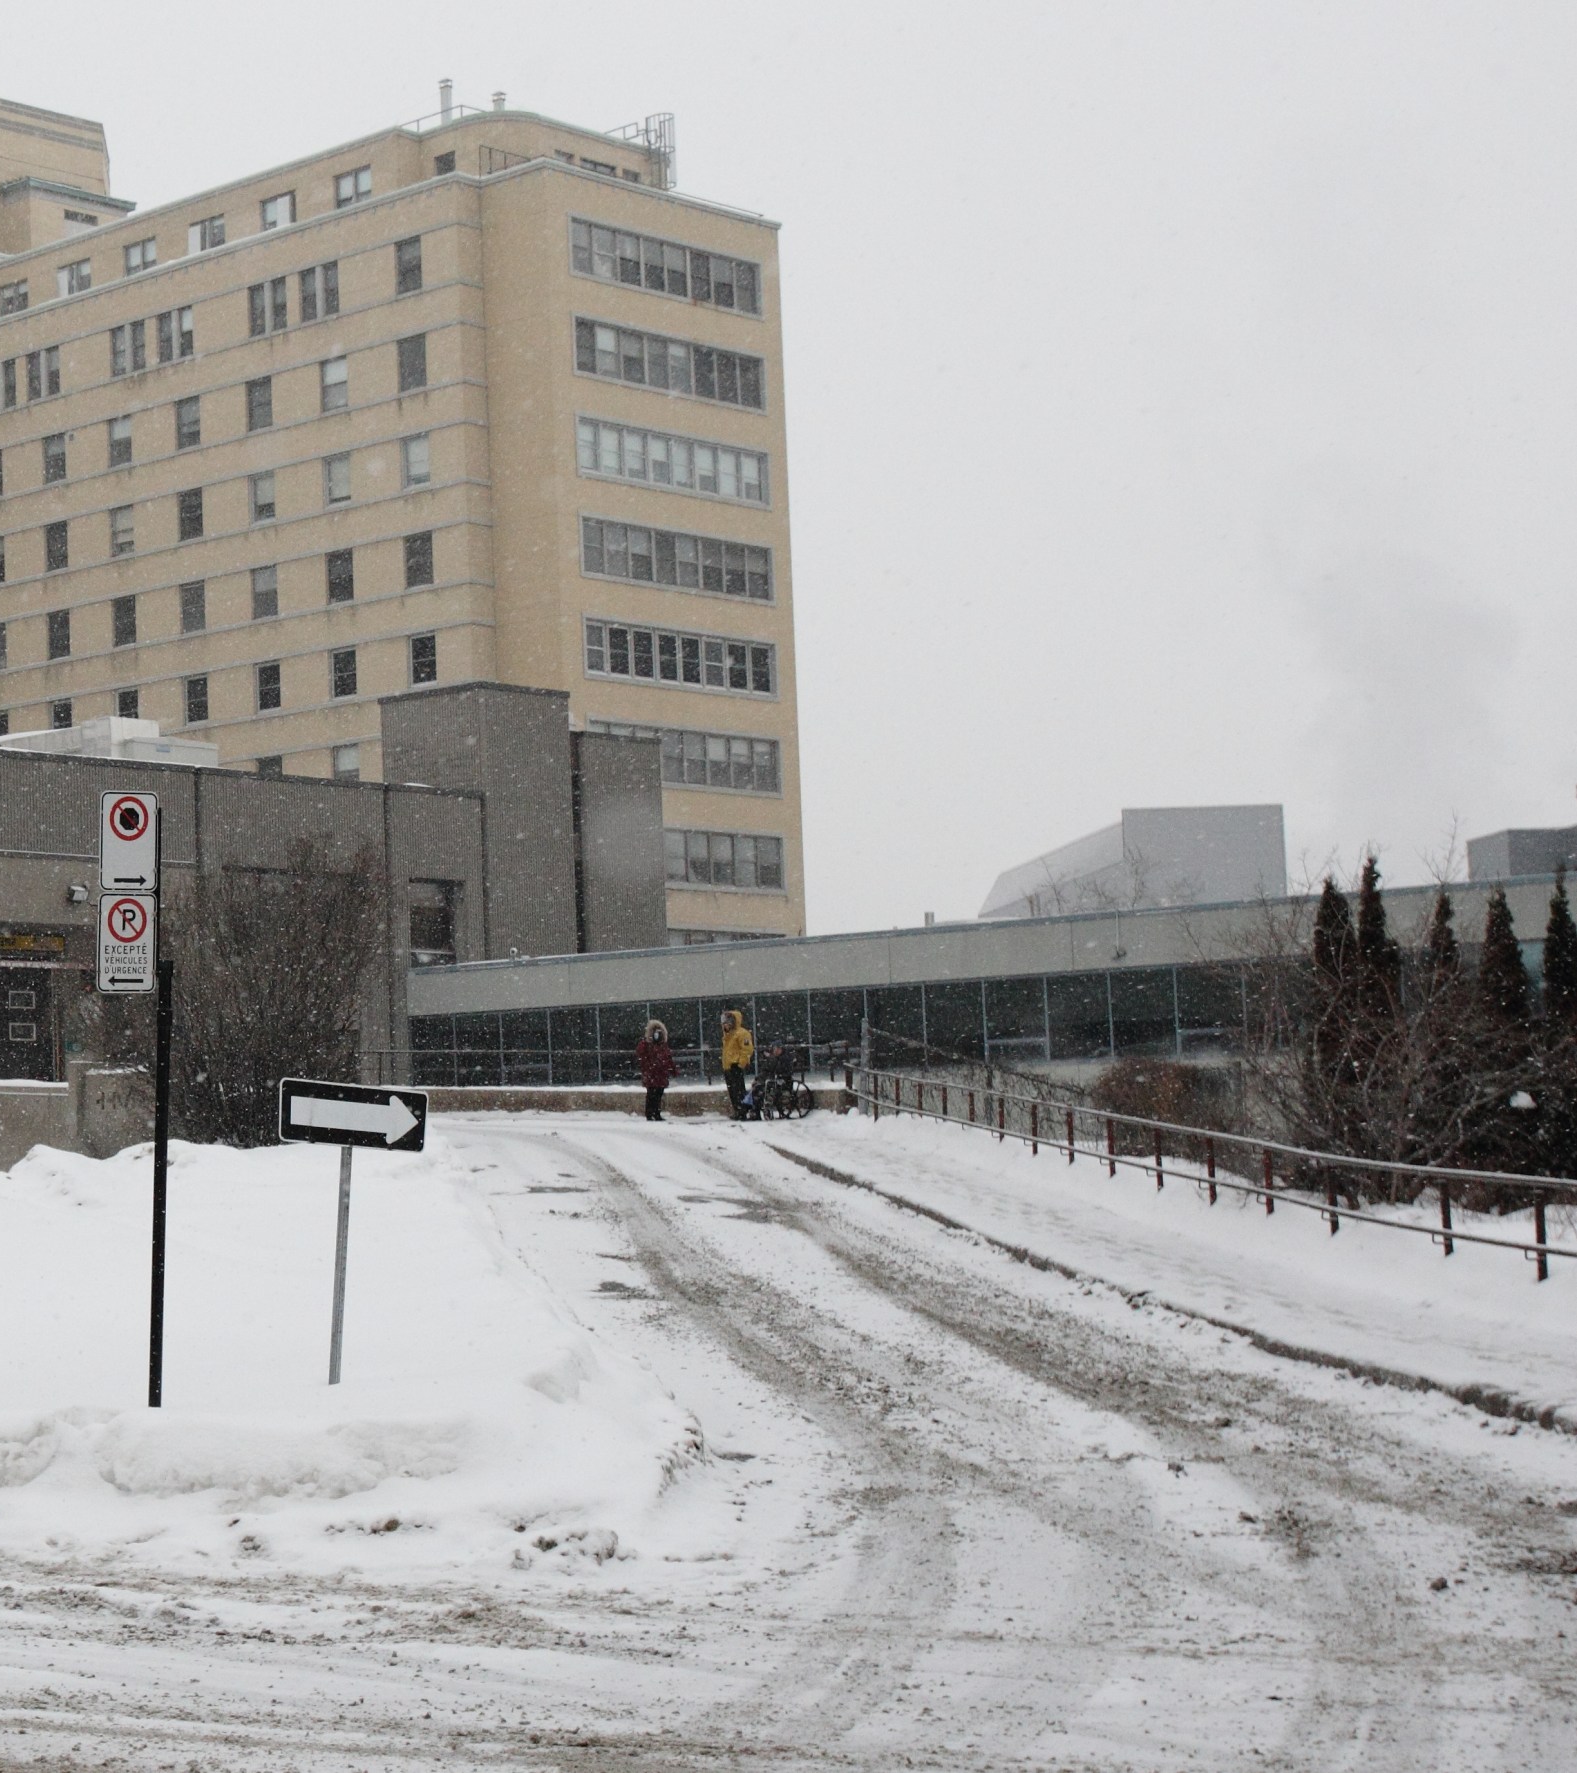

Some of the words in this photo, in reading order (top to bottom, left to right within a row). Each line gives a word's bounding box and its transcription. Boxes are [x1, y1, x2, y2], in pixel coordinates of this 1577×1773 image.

[104, 942, 148, 955] EXCEPTÉ
[104, 953, 148, 965] VÉHICULES
[104, 964, 148, 975] D'URGENCE
